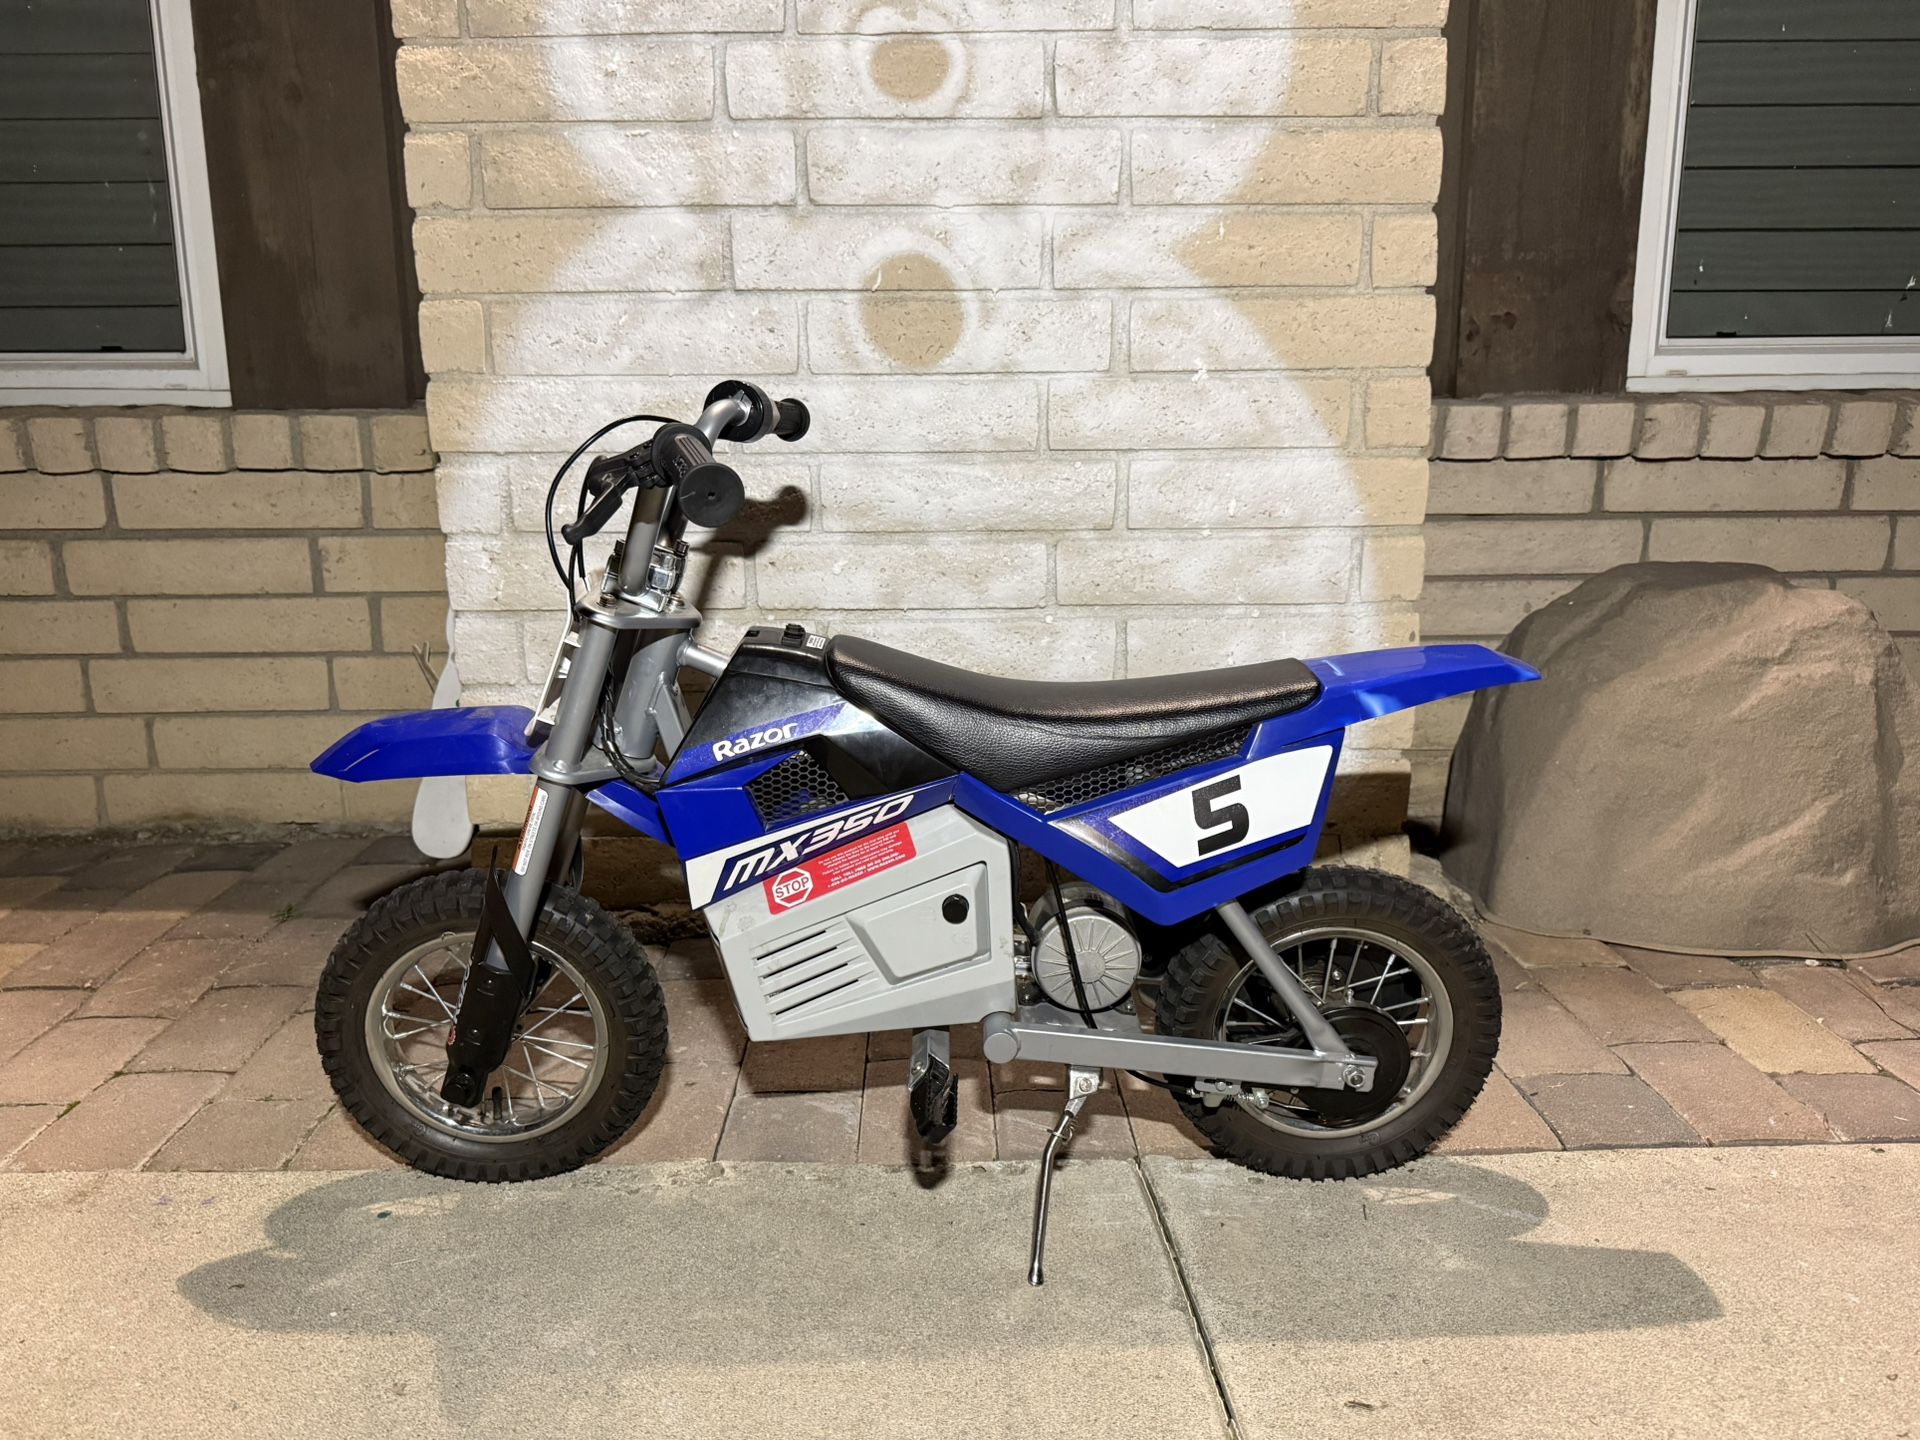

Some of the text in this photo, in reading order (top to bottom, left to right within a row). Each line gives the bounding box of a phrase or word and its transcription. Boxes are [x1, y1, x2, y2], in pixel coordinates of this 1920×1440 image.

[712, 723, 798, 761] Razor
[723, 795, 914, 891] MX350
[1191, 774, 1250, 856] 5
[775, 877, 810, 899] STOP
